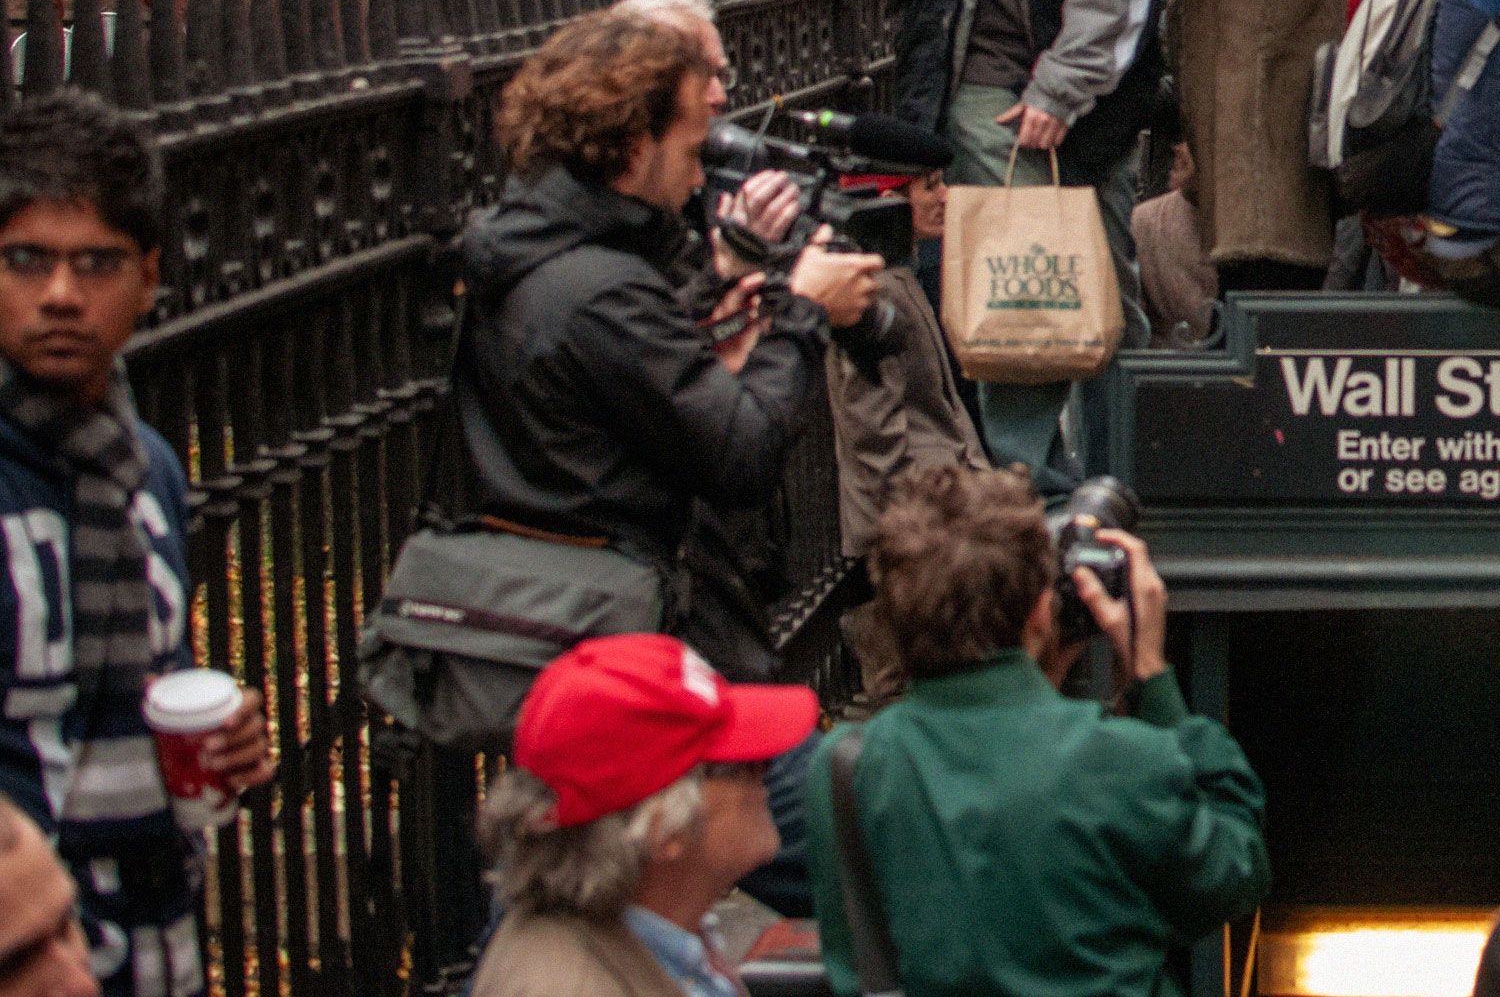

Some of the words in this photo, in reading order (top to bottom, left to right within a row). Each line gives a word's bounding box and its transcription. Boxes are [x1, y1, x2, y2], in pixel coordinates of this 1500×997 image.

[986, 254, 1080, 275] WHOLE
[989, 277, 1080, 299] FOODS
[1281, 357, 1416, 418] Wall
[1338, 430, 1427, 462] Enter
[1338, 469, 1375, 493] or
[1386, 469, 1448, 494] see
